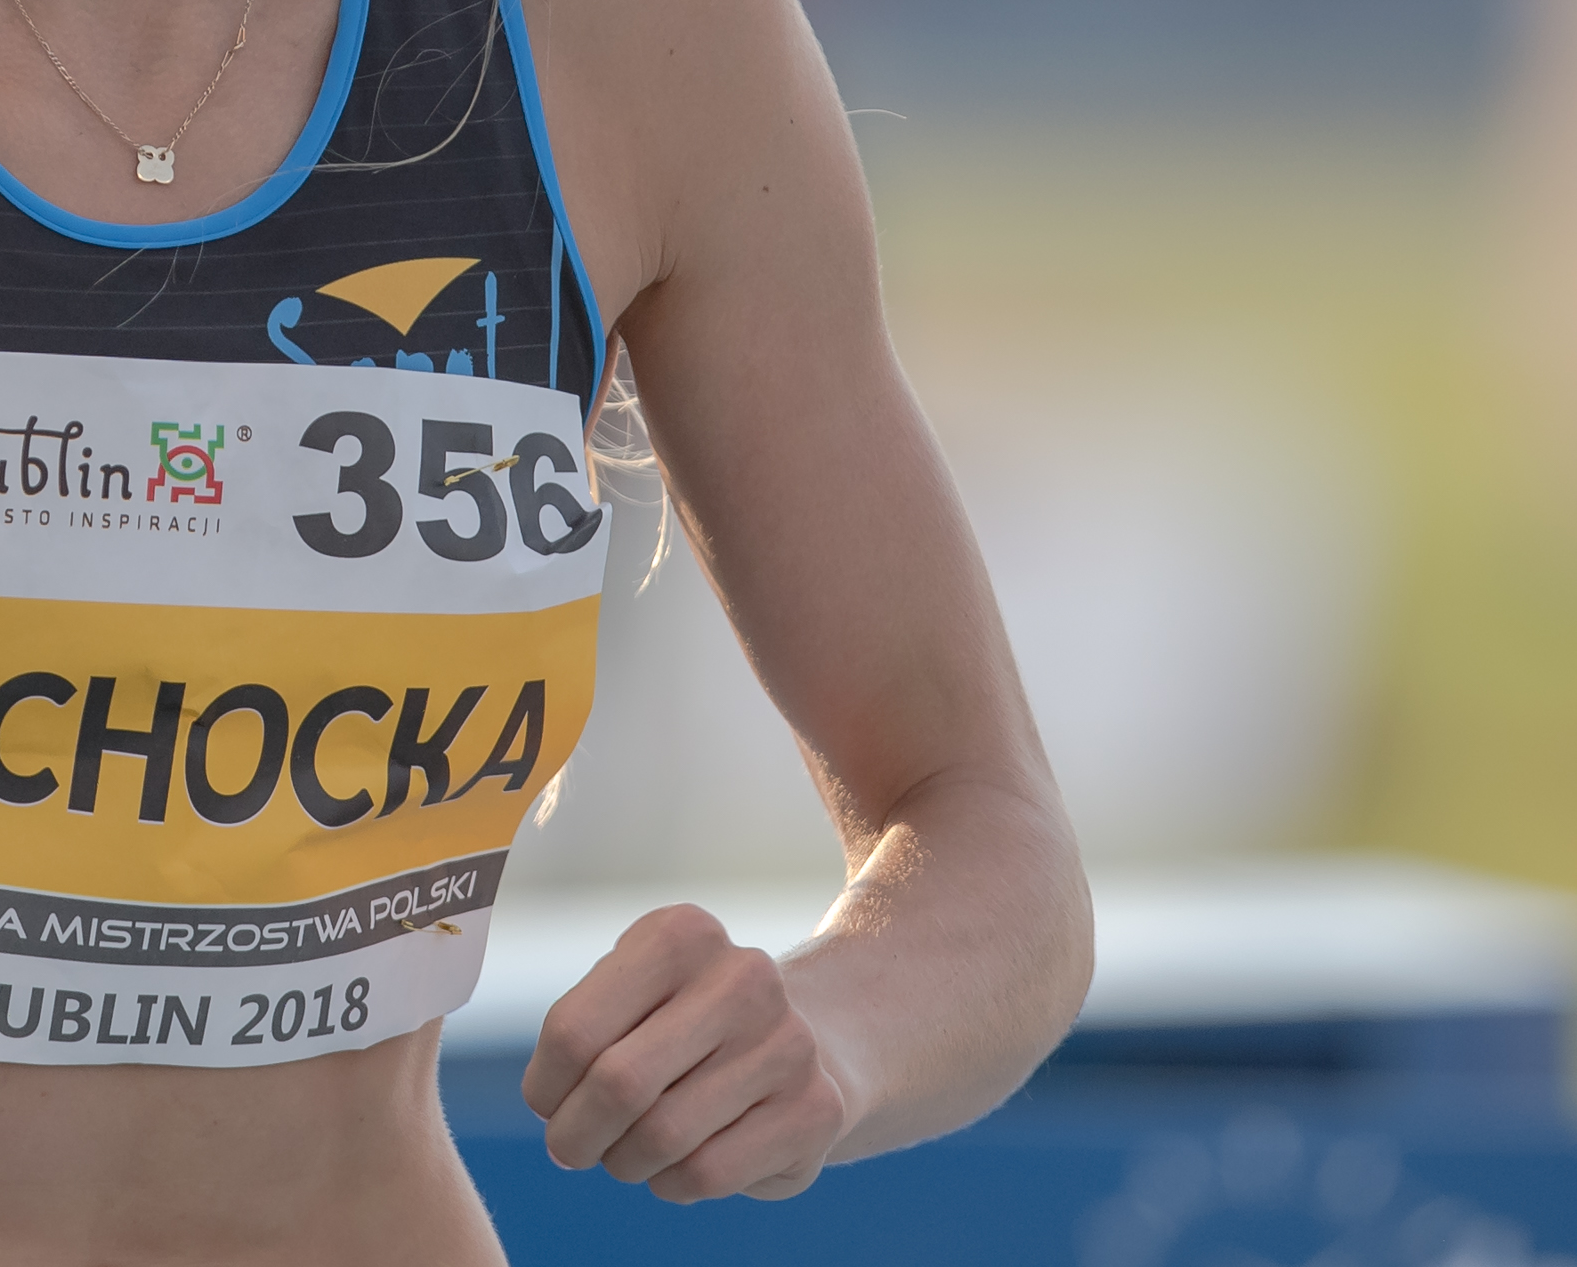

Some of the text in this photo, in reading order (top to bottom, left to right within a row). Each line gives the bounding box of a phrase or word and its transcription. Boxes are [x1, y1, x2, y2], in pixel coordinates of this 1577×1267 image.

[70, 512, 221, 536] INSPIRACJI
[292, 411, 603, 562] 356
[40, 907, 362, 952] MISTRZOSTWA
[369, 870, 478, 930] POLSKI
[231, 976, 370, 1046] 2018
